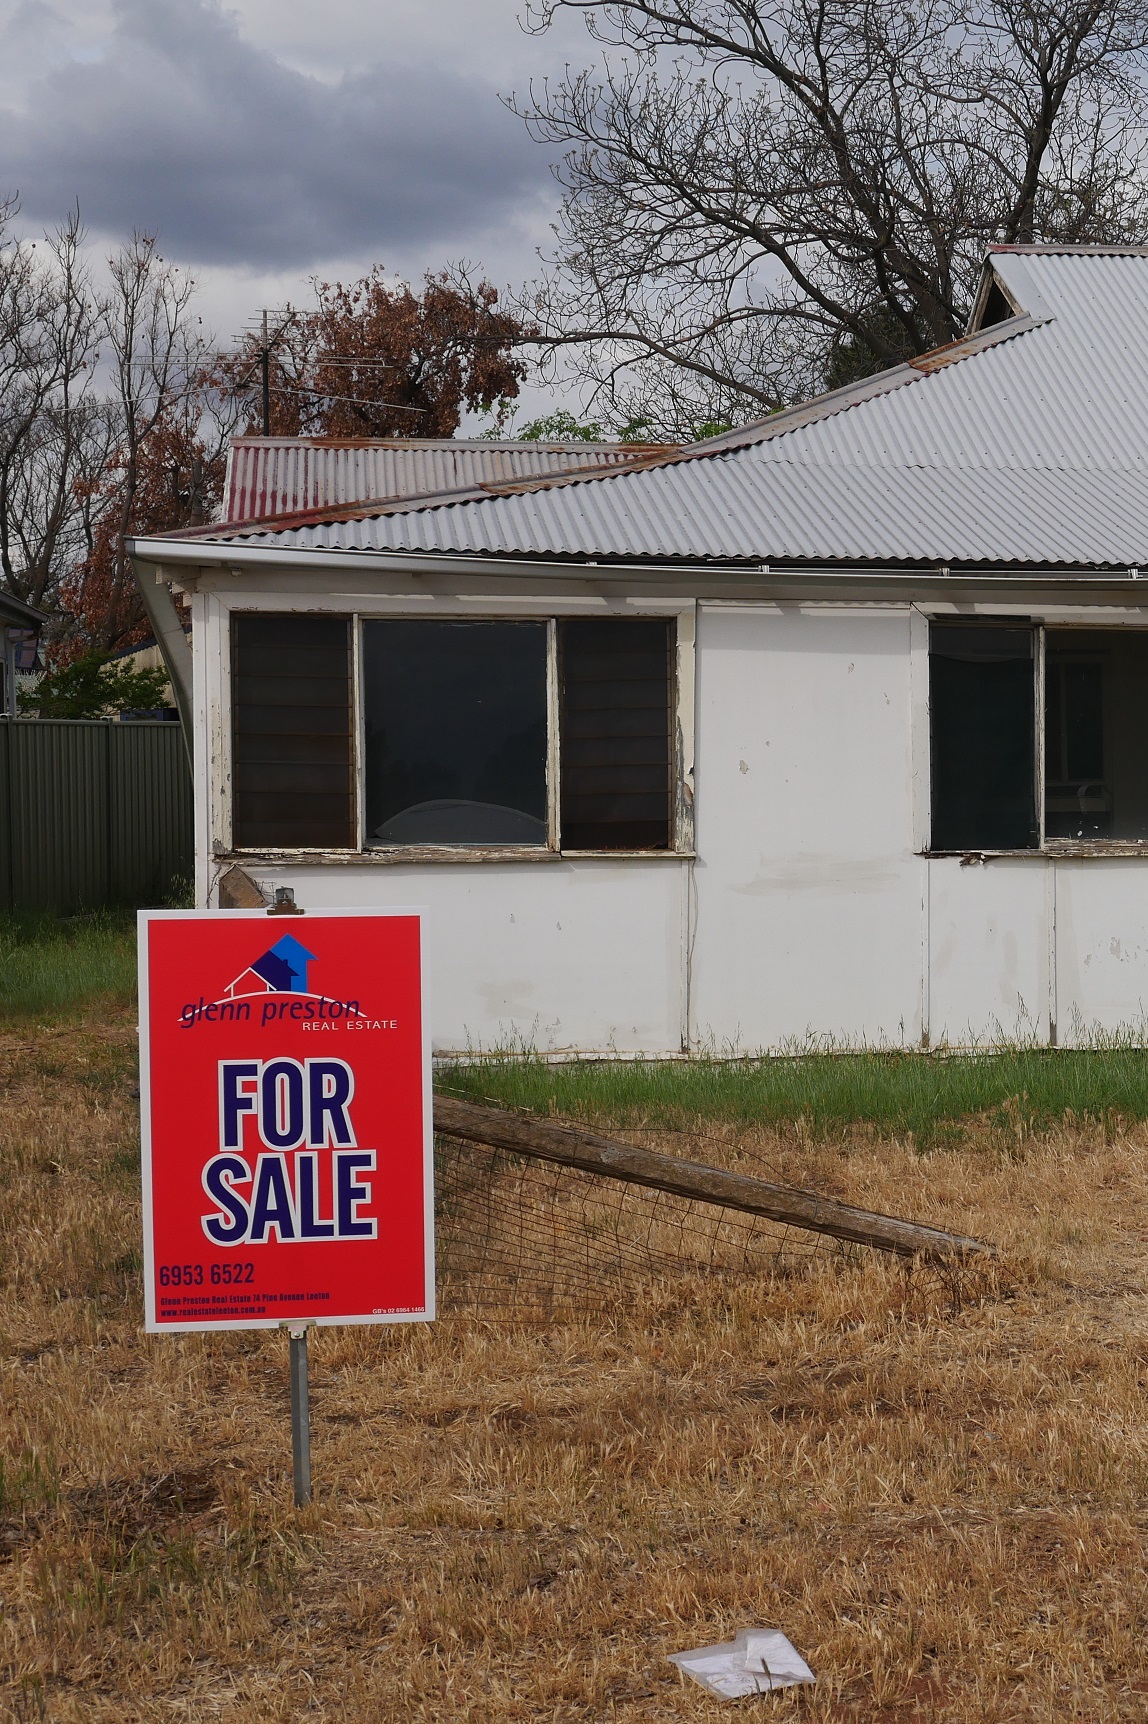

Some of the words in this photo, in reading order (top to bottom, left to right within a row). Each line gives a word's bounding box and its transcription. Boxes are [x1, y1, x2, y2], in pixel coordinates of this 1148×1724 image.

[181, 997, 251, 1028] glenn
[261, 996, 359, 1027] preston
[302, 1021, 339, 1031] REAL
[346, 1020, 398, 1030] ESTATE
[218, 1057, 357, 1151] FOR
[201, 1150, 377, 1247] SALE
[159, 1264, 204, 1286] 6953
[210, 1263, 255, 1285] 6522
[160, 1297, 181, 1306] Glenn
[183, 1296, 210, 1305] Preston
[212, 1295, 228, 1304] Real
[229, 1294, 251, 1303] Estate
[262, 1293, 278, 1302] Pine
[279, 1293, 305, 1301] Avenue
[306, 1292, 330, 1300] Leeton
[161, 1306, 266, 1317] www.realestateleeton.com.au
